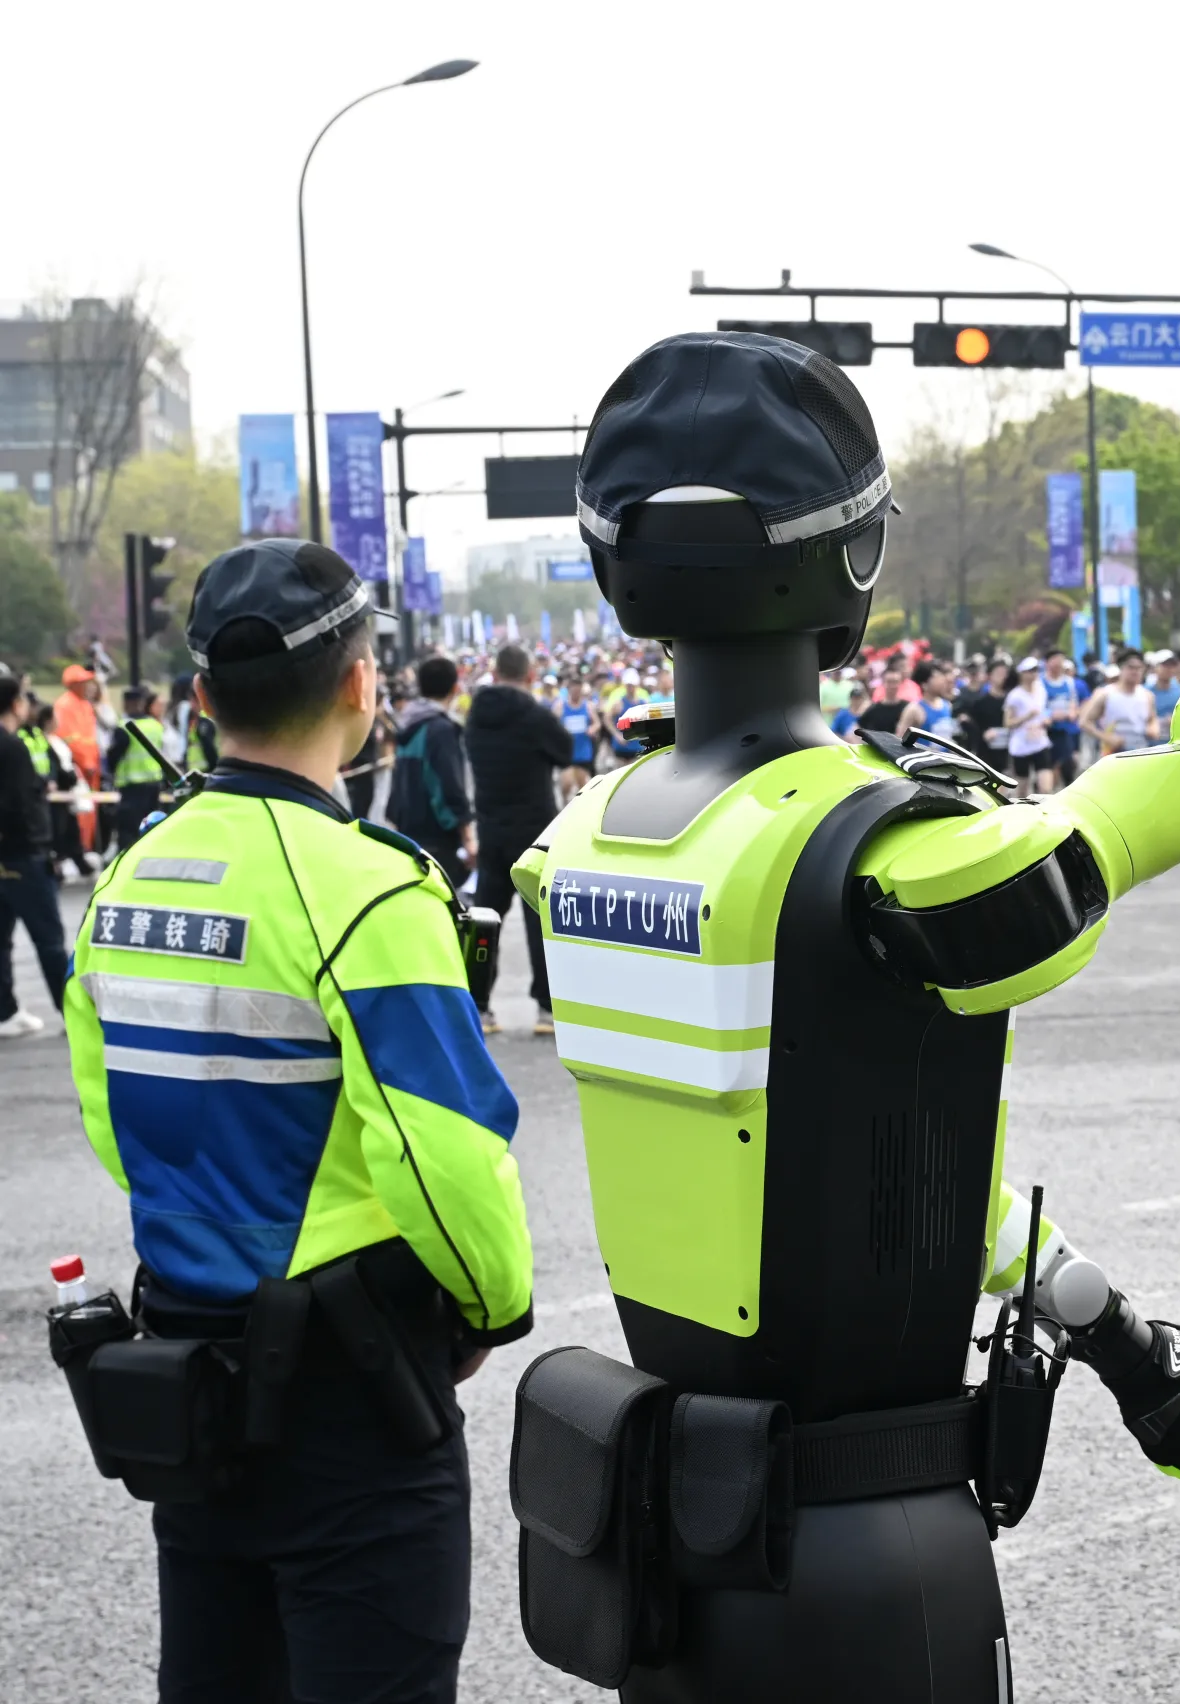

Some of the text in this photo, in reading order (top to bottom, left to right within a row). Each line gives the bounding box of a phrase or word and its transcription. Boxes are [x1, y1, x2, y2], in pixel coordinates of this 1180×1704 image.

[856, 483, 882, 513] POLICE
[99, 908, 232, 955] 交警铁骑
